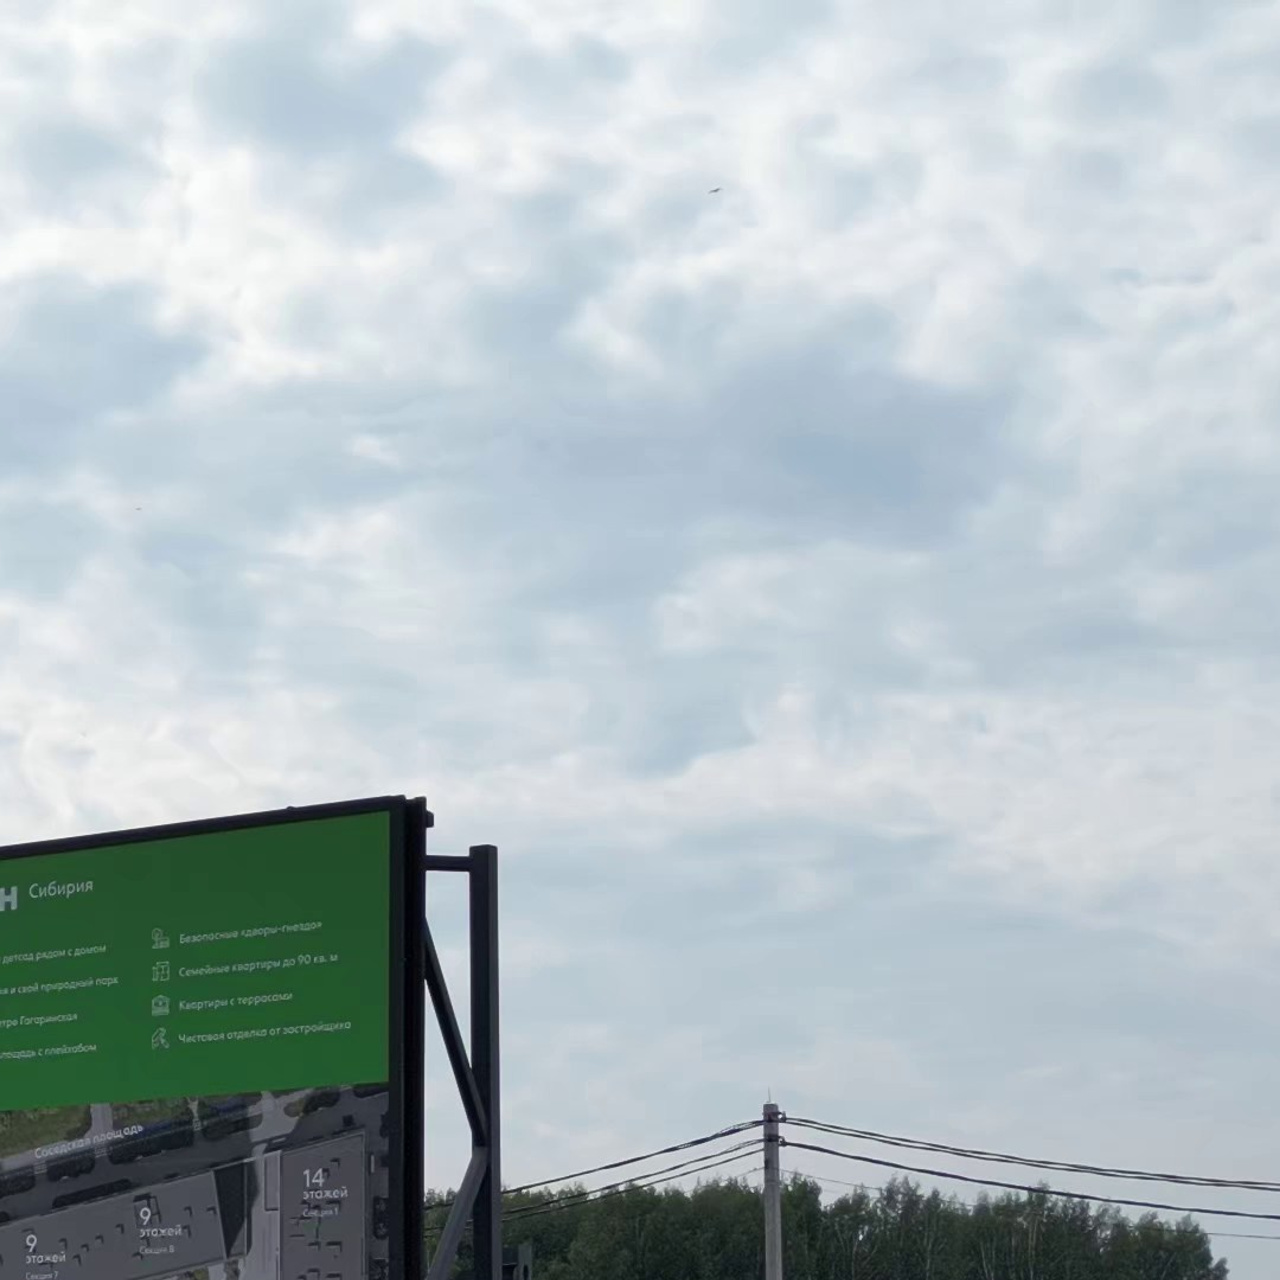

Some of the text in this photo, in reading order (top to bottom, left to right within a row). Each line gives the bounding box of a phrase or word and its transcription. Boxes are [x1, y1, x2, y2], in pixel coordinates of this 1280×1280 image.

[29, 880, 94, 899] Сибирия
[179, 930, 239, 944] Безопасные
[35, 950, 66, 962] рядом
[67, 948, 73, 957] с
[74, 945, 107, 957] домом
[178, 964, 230, 977] Семейные
[231, 960, 281, 973] квартиры
[282, 958, 296, 969] до
[297, 954, 312, 965] 90
[10, 986, 16, 995] и
[17, 982, 39, 994] свой
[40, 976, 94, 993] природный
[95, 976, 119, 988] парк
[179, 993, 293, 1012] Квартиры с террасами
[226, 1028, 268, 1041] отделка
[268, 1027, 281, 1037] от
[282, 1020, 352, 1036] застройщика
[37, 1048, 44, 1057] с
[93, 1124, 144, 1146] площадь
[302, 1168, 325, 1188] 14
[302, 1186, 348, 1200] этажей
[139, 1207, 151, 1226] 9
[139, 1224, 182, 1238] этажей
[25, 1234, 38, 1253] 9
[25, 1251, 66, 1264] этажей
